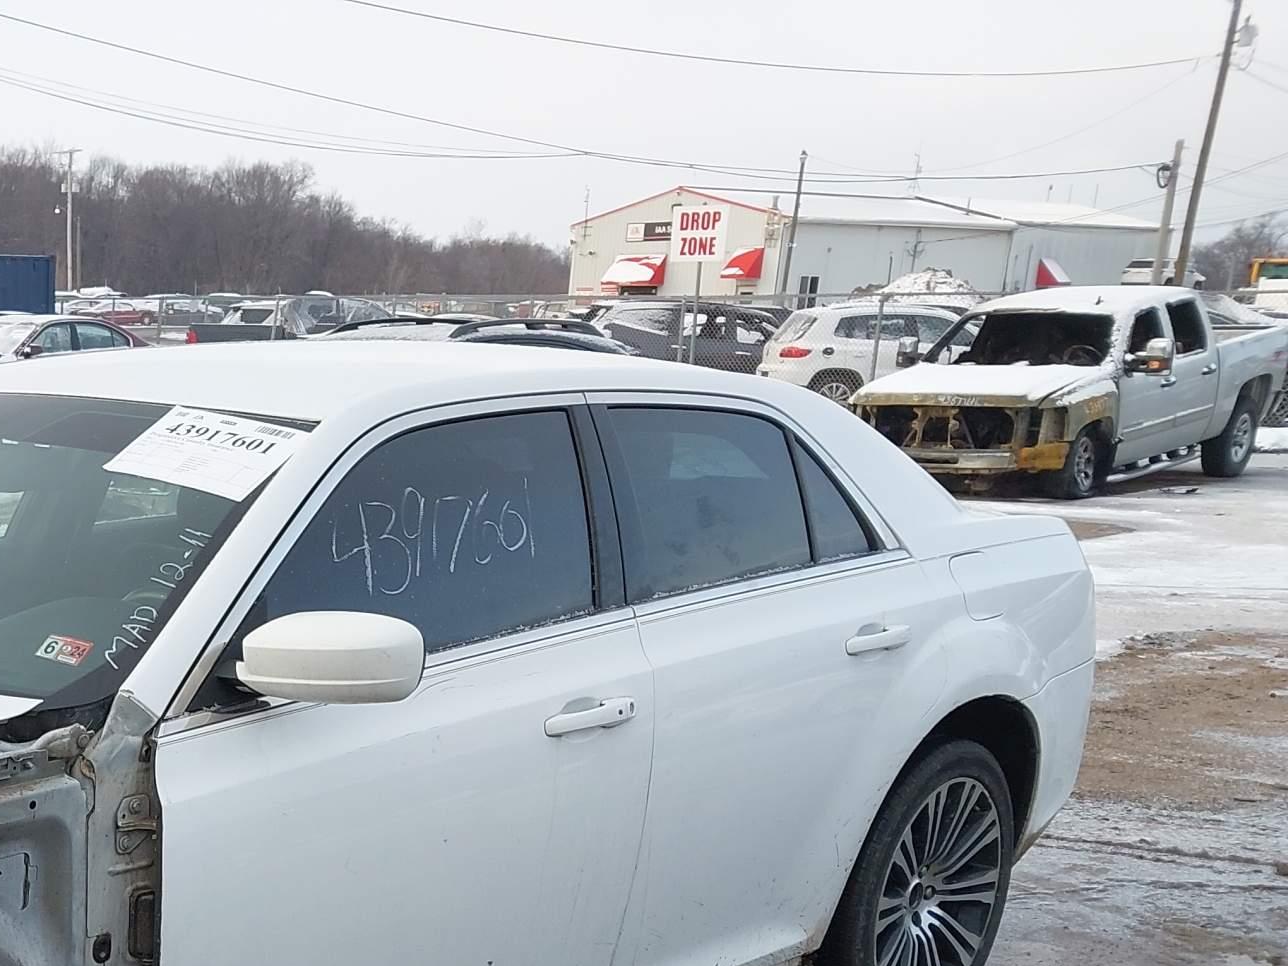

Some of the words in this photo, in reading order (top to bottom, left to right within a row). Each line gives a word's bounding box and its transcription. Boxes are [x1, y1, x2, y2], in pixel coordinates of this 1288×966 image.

[679, 211, 722, 231] DROP
[679, 236, 717, 256] ZONE
[164, 422, 278, 455] 43917601
[331, 476, 535, 597] 43917601
[43, 640, 59, 655] 6
[104, 605, 159, 670] MAD
